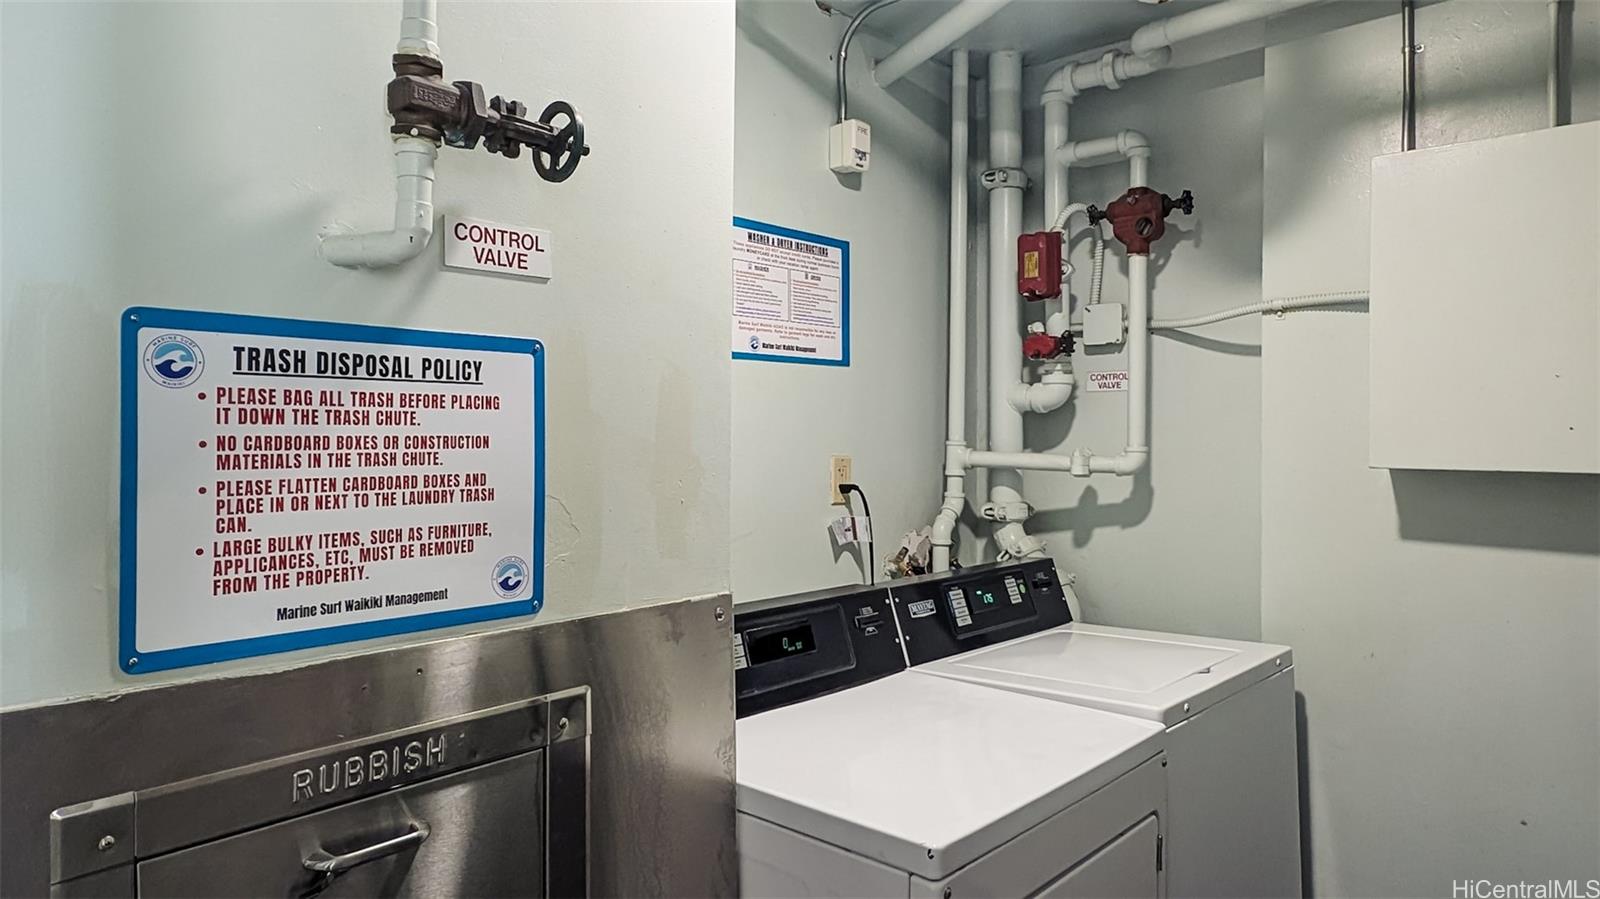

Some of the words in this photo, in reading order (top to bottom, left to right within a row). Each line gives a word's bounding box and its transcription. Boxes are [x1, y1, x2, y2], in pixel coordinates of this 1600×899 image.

[454, 222, 545, 252] CONTROL
[747, 231, 770, 244] WASHER
[473, 246, 528, 270] VALVE
[233, 346, 306, 374] TRASH
[317, 351, 413, 378] DISPOSAL
[421, 358, 482, 381] POLICY
[1090, 372, 1129, 382] CONTROL
[1097, 381, 1122, 389] VALVE
[216, 387, 276, 405] PLEASE
[283, 389, 313, 406] BAG
[319, 390, 345, 407] ALL
[350, 391, 394, 408] TRASH
[400, 393, 446, 409] BEFORE
[451, 395, 500, 410] PLACING
[216, 408, 231, 425] IT
[238, 408, 285, 425] DOWN
[292, 409, 319, 425] THE
[325, 410, 370, 426] TRASH
[376, 411, 421, 426] CHUTE.
[216, 435, 237, 451] NO
[244, 435, 330, 451] CARDBOARD
[336, 435, 378, 450] BOXES
[383, 435, 399, 450] OR
[404, 435, 490, 449] CONSTRUCTION
[216, 453, 302, 470] MATERIALS
[308, 453, 321, 468] IN
[327, 453, 351, 468] THE
[357, 452, 397, 467] TRASH
[402, 452, 443, 466] CHUTE.
[216, 480, 272, 497] PLEASE
[279, 477, 337, 495] FLATTEN
[343, 475, 418, 492] CARDBOARD
[423, 474, 460, 488] BOXES
[465, 473, 487, 487] AND
[216, 498, 264, 516] PLACE
[270, 497, 284, 513] IN
[291, 496, 309, 512] OR
[315, 494, 348, 510] NEXT
[354, 493, 369, 508] TO
[375, 492, 397, 507] THE
[402, 490, 455, 506] LAUNDRY
[460, 488, 495, 503] TRASH
[216, 516, 252, 534] CAN.
[213, 538, 262, 558] LARGE
[268, 534, 313, 553] BULKY
[370, 528, 403, 545] SUCH
[408, 527, 423, 542] AS
[428, 522, 492, 540] FURNITURE,
[213, 552, 320, 577] APPLICANCES,
[325, 549, 354, 566] ETC,
[360, 545, 395, 563] MUST
[400, 543, 415, 559] BE
[420, 539, 474, 557] REMOVED
[213, 576, 257, 596] FROM
[264, 572, 290, 590] THE
[296, 565, 369, 587] PROPERTY.
[276, 605, 317, 621] Marine
[320, 600, 341, 616] Surf
[345, 595, 383, 612] Waikiki
[385, 588, 448, 607] Management
[292, 733, 448, 803] RUBBISH
